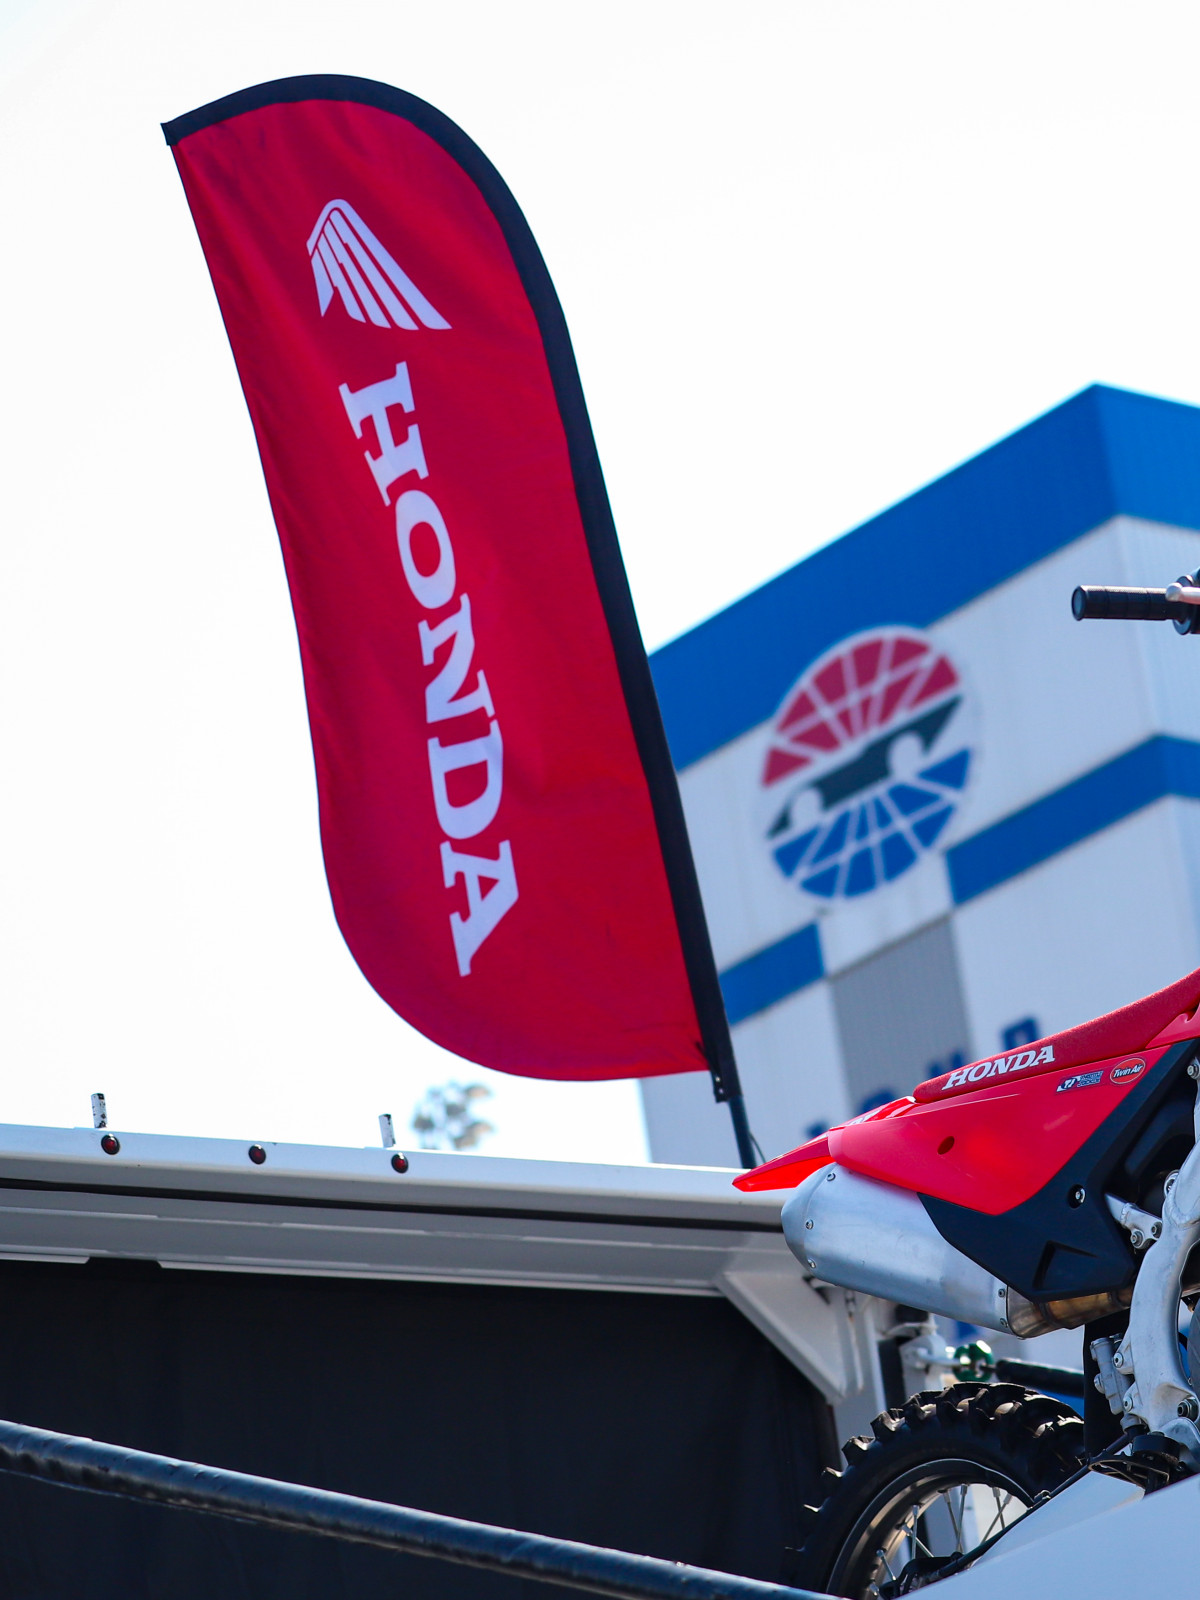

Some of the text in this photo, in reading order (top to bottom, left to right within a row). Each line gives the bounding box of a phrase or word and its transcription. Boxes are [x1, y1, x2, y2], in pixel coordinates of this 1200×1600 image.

[338, 360, 519, 977] HONDA
[941, 1045, 1056, 1090] HONDA
[1113, 1064, 1144, 1078] Twin Air
